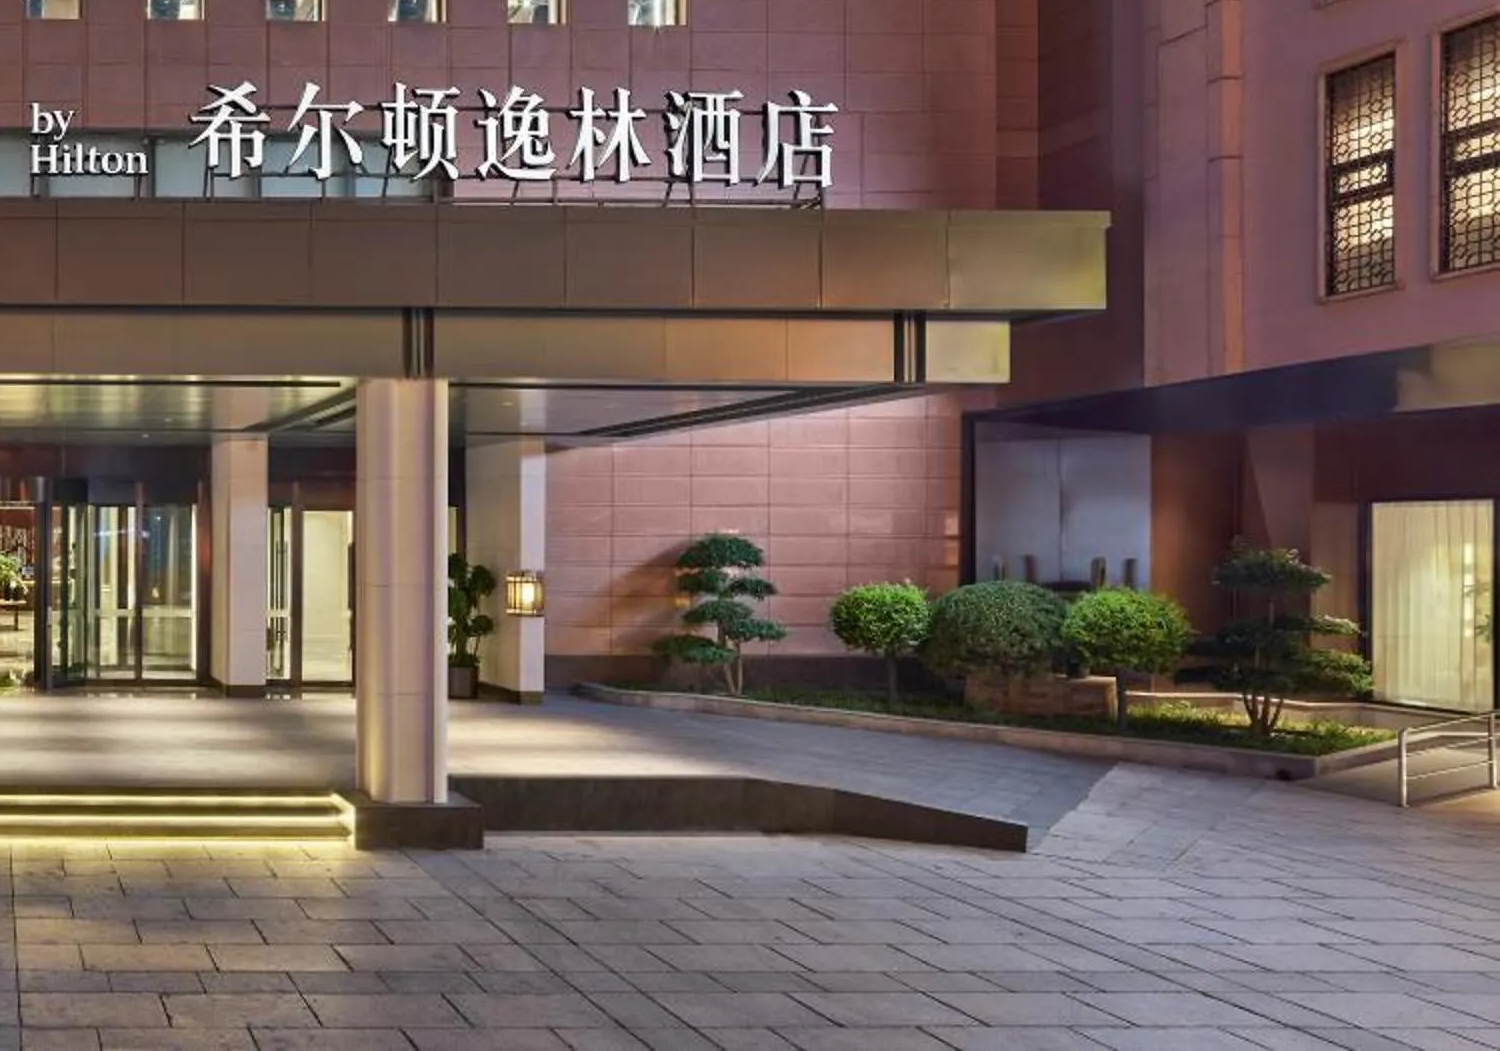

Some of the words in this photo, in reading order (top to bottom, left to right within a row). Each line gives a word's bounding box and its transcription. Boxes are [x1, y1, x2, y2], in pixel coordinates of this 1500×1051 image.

[30, 102, 75, 140] by
[188, 81, 839, 188] 希尔顿逸林酒店
[30, 142, 149, 174] Hilton
